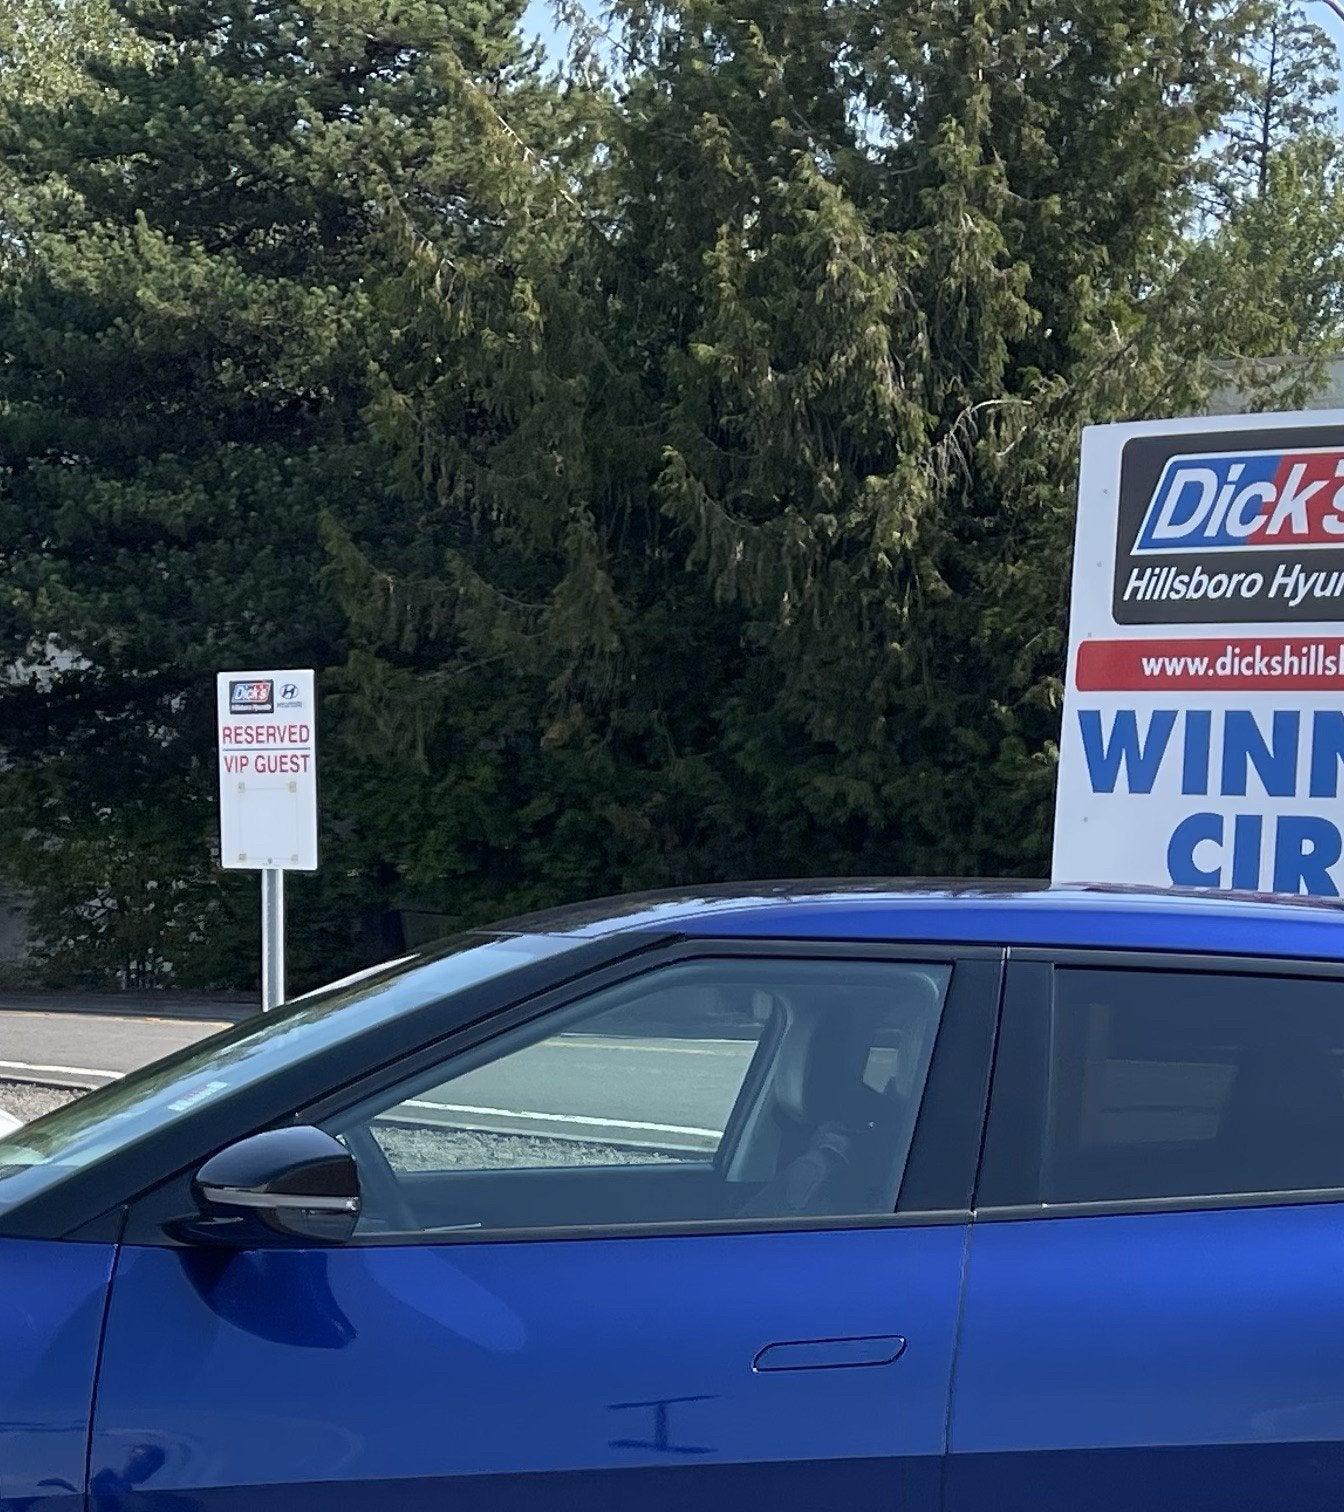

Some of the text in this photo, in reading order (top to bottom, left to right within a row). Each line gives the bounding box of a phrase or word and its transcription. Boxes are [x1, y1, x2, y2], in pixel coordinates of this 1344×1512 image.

[1122, 565, 1265, 602] Hillsboro
[222, 724, 310, 744] RESERVED
[224, 754, 311, 773] VIP GUEST
